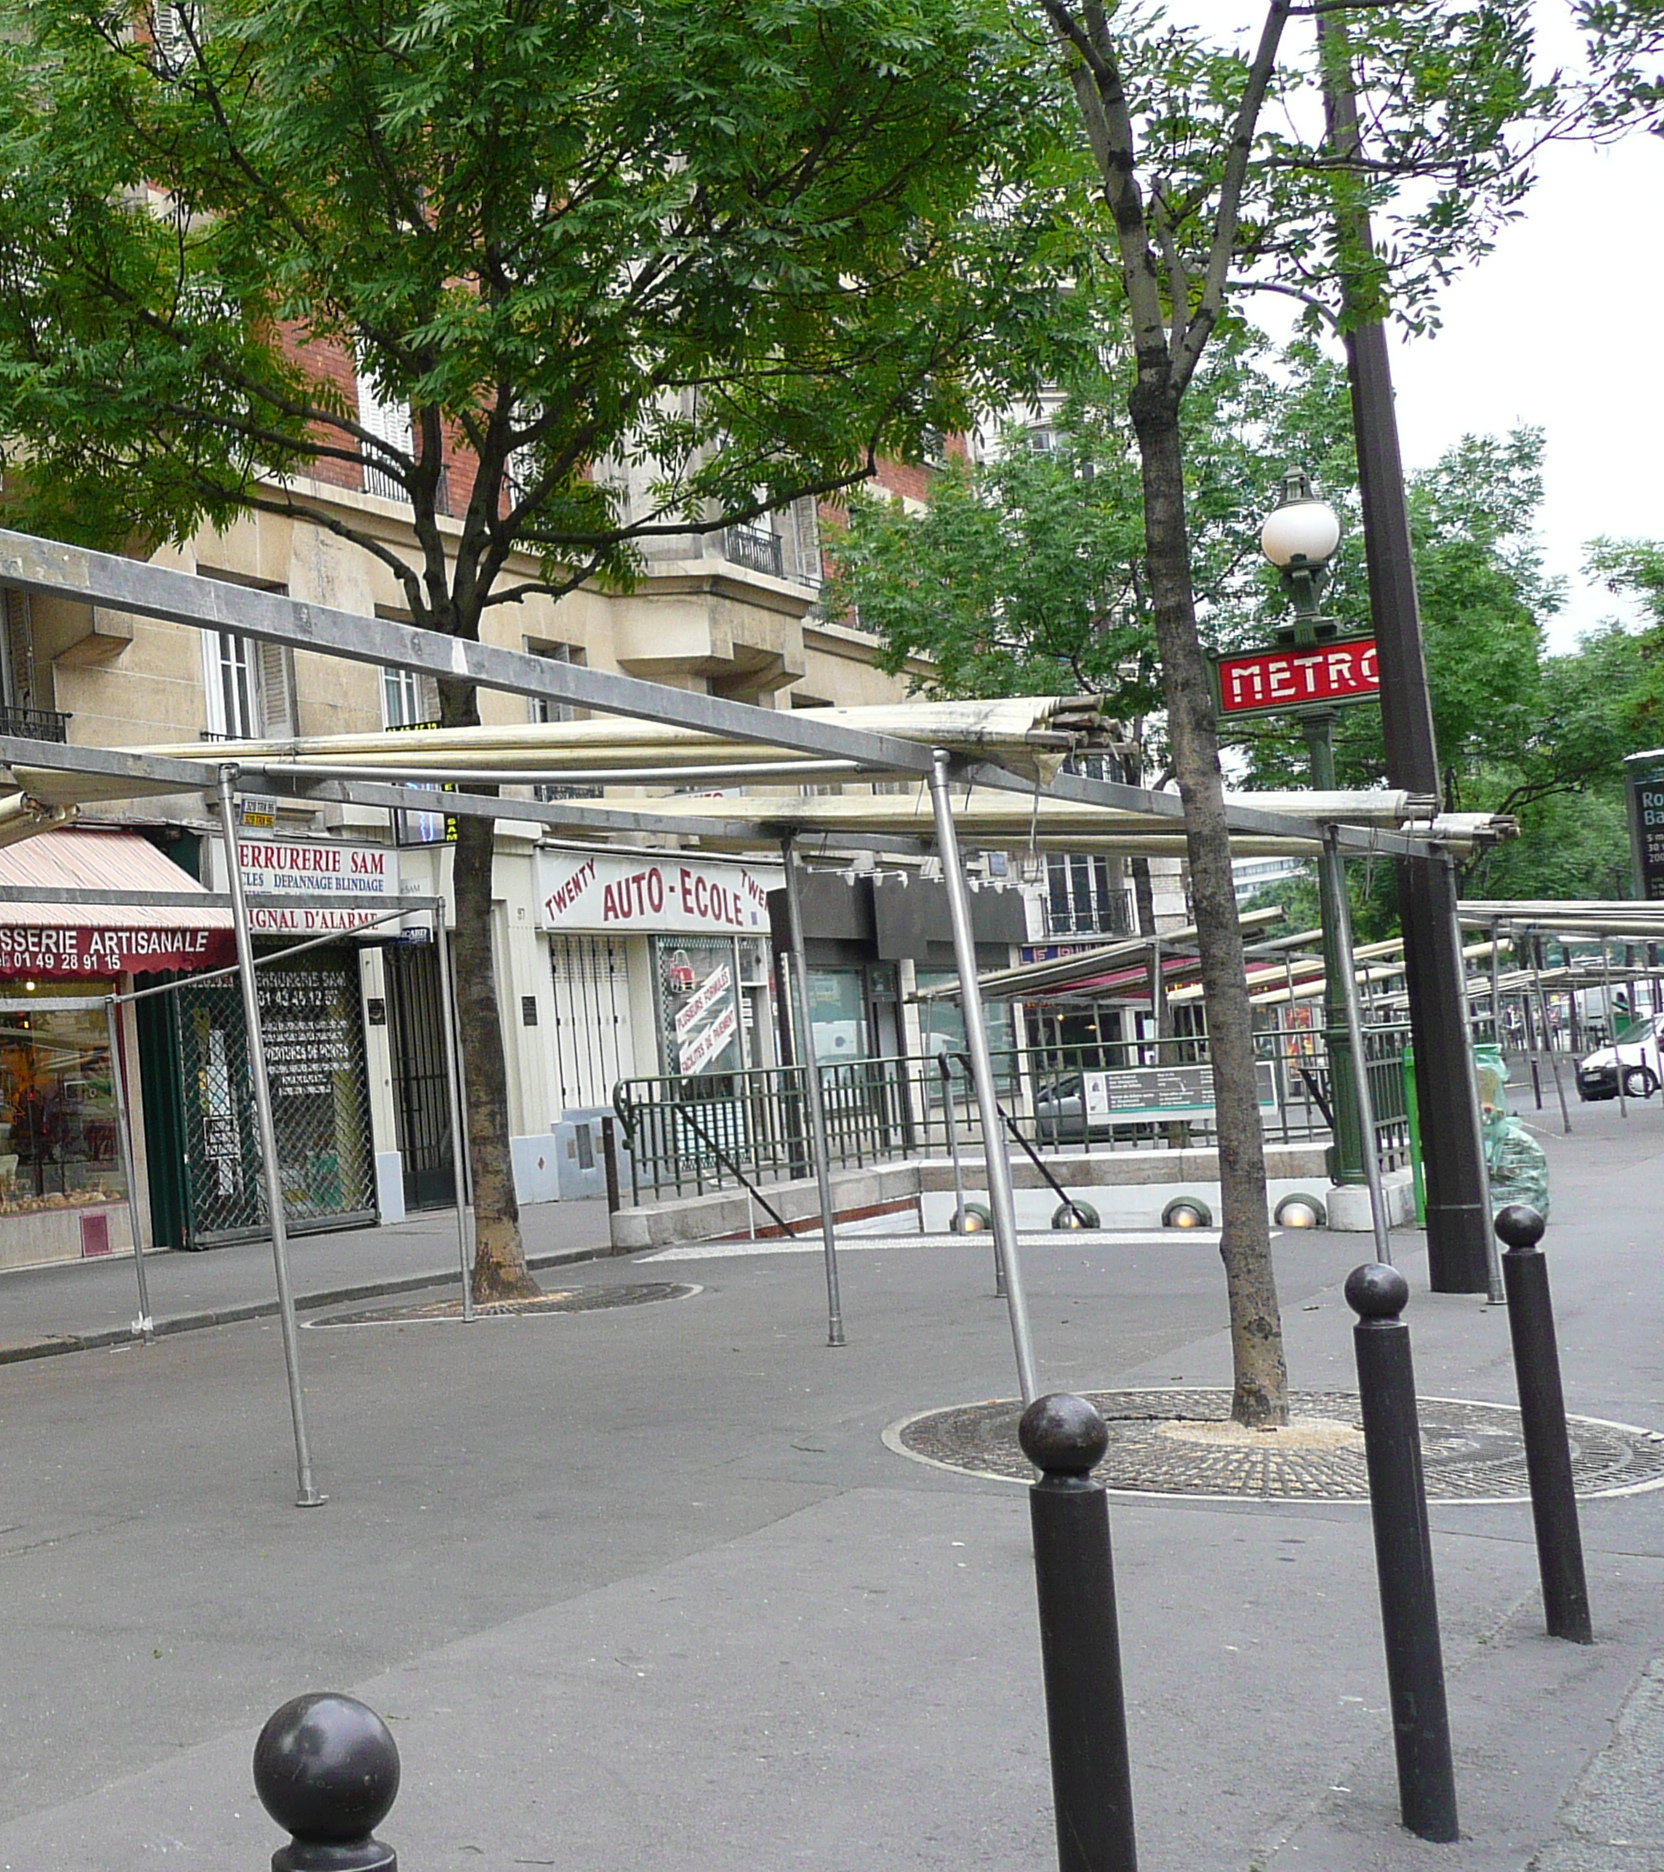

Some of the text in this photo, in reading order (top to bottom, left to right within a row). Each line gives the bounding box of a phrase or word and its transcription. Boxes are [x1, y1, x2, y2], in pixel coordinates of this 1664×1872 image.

[446, 817, 458, 842] SAM
[238, 844, 385, 875] ERRURERIE SAM
[274, 873, 333, 891] DEPANNAGE
[335, 877, 384, 893] BLINDAGE
[545, 857, 597, 921] TWENTY
[247, 909, 380, 931] IGNAL D'ALARME
[89, 929, 210, 955] ARTISANALE
[13, 953, 32, 969] 01
[36, 953, 55, 969] 49
[61, 953, 78, 970] 28
[82, 953, 98, 970] 91
[104, 953, 122, 970] 15
[255, 970, 318, 988] ERRURERIE
